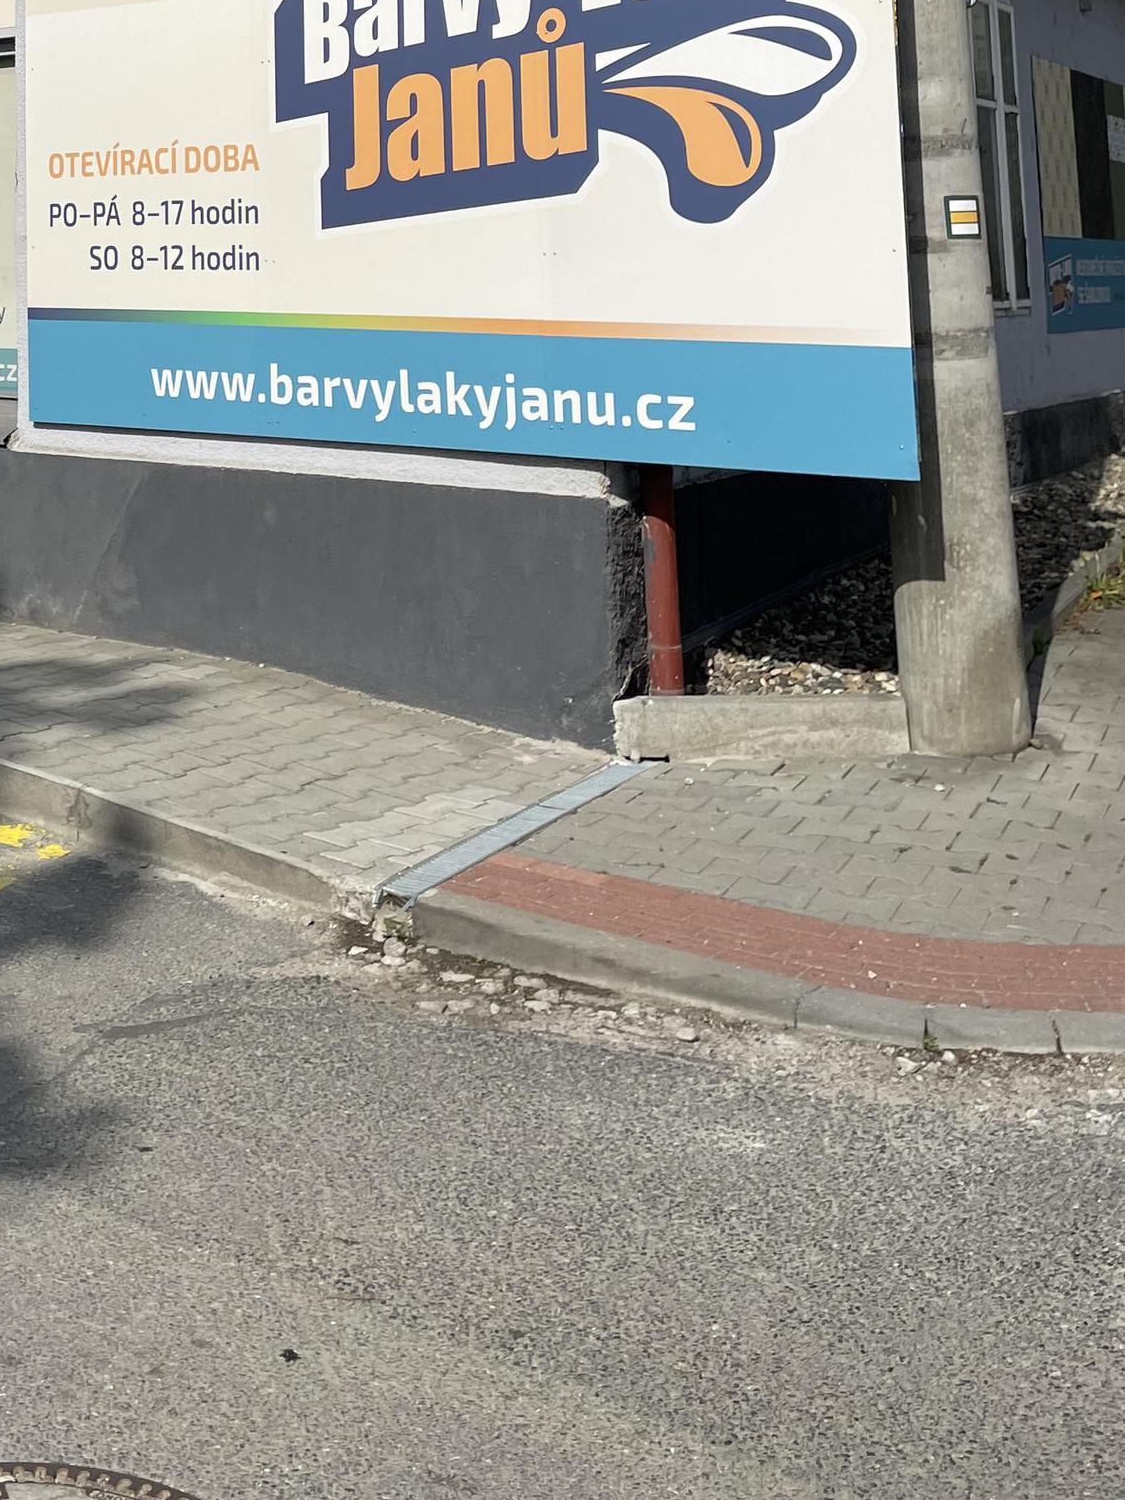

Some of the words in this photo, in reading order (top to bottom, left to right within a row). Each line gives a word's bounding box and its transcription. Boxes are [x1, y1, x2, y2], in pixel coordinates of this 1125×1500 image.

[345, 8, 588, 191] Janů
[48, 139, 179, 179] OTEVÍRACÍ
[184, 143, 260, 174] DOBA
[191, 198, 259, 225] hodin
[89, 245, 119, 271] SO
[191, 244, 260, 271] hodin
[151, 363, 696, 431] www.barvylakyjanu.cz
